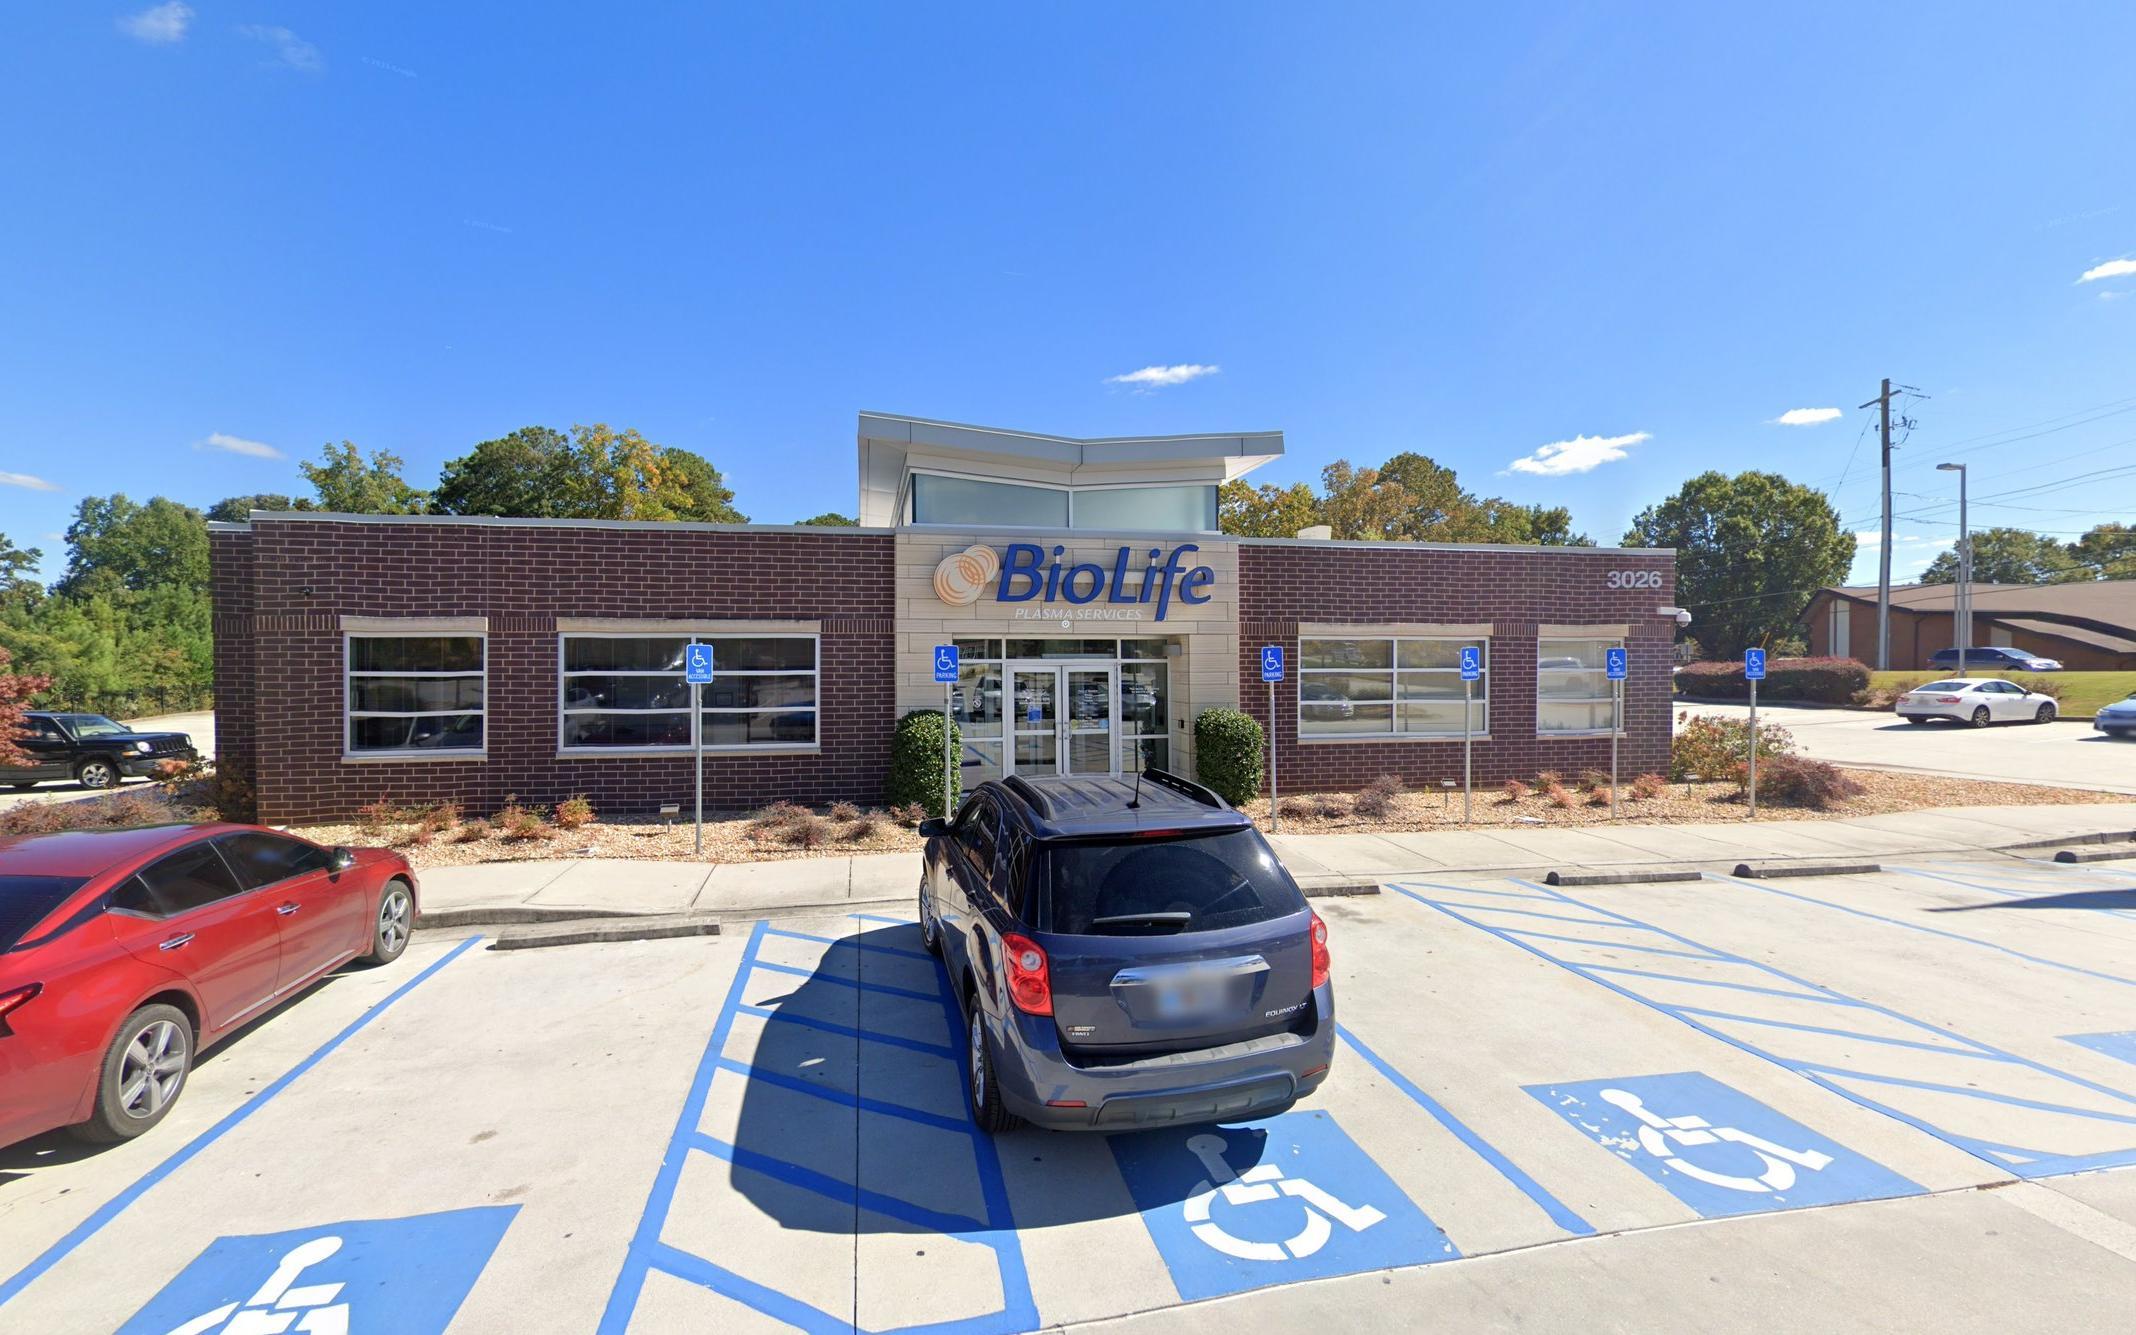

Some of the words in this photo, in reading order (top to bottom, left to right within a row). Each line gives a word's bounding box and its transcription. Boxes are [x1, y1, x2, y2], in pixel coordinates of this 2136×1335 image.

[996, 543, 1215, 622] BioLife
[1607, 570, 1663, 588] 3026
[1015, 608, 1073, 620] PLASMA
[1076, 608, 1143, 620] SERVICES
[936, 671, 957, 679] PARKING
[1265, 1004, 1298, 1018] EQUINOX
